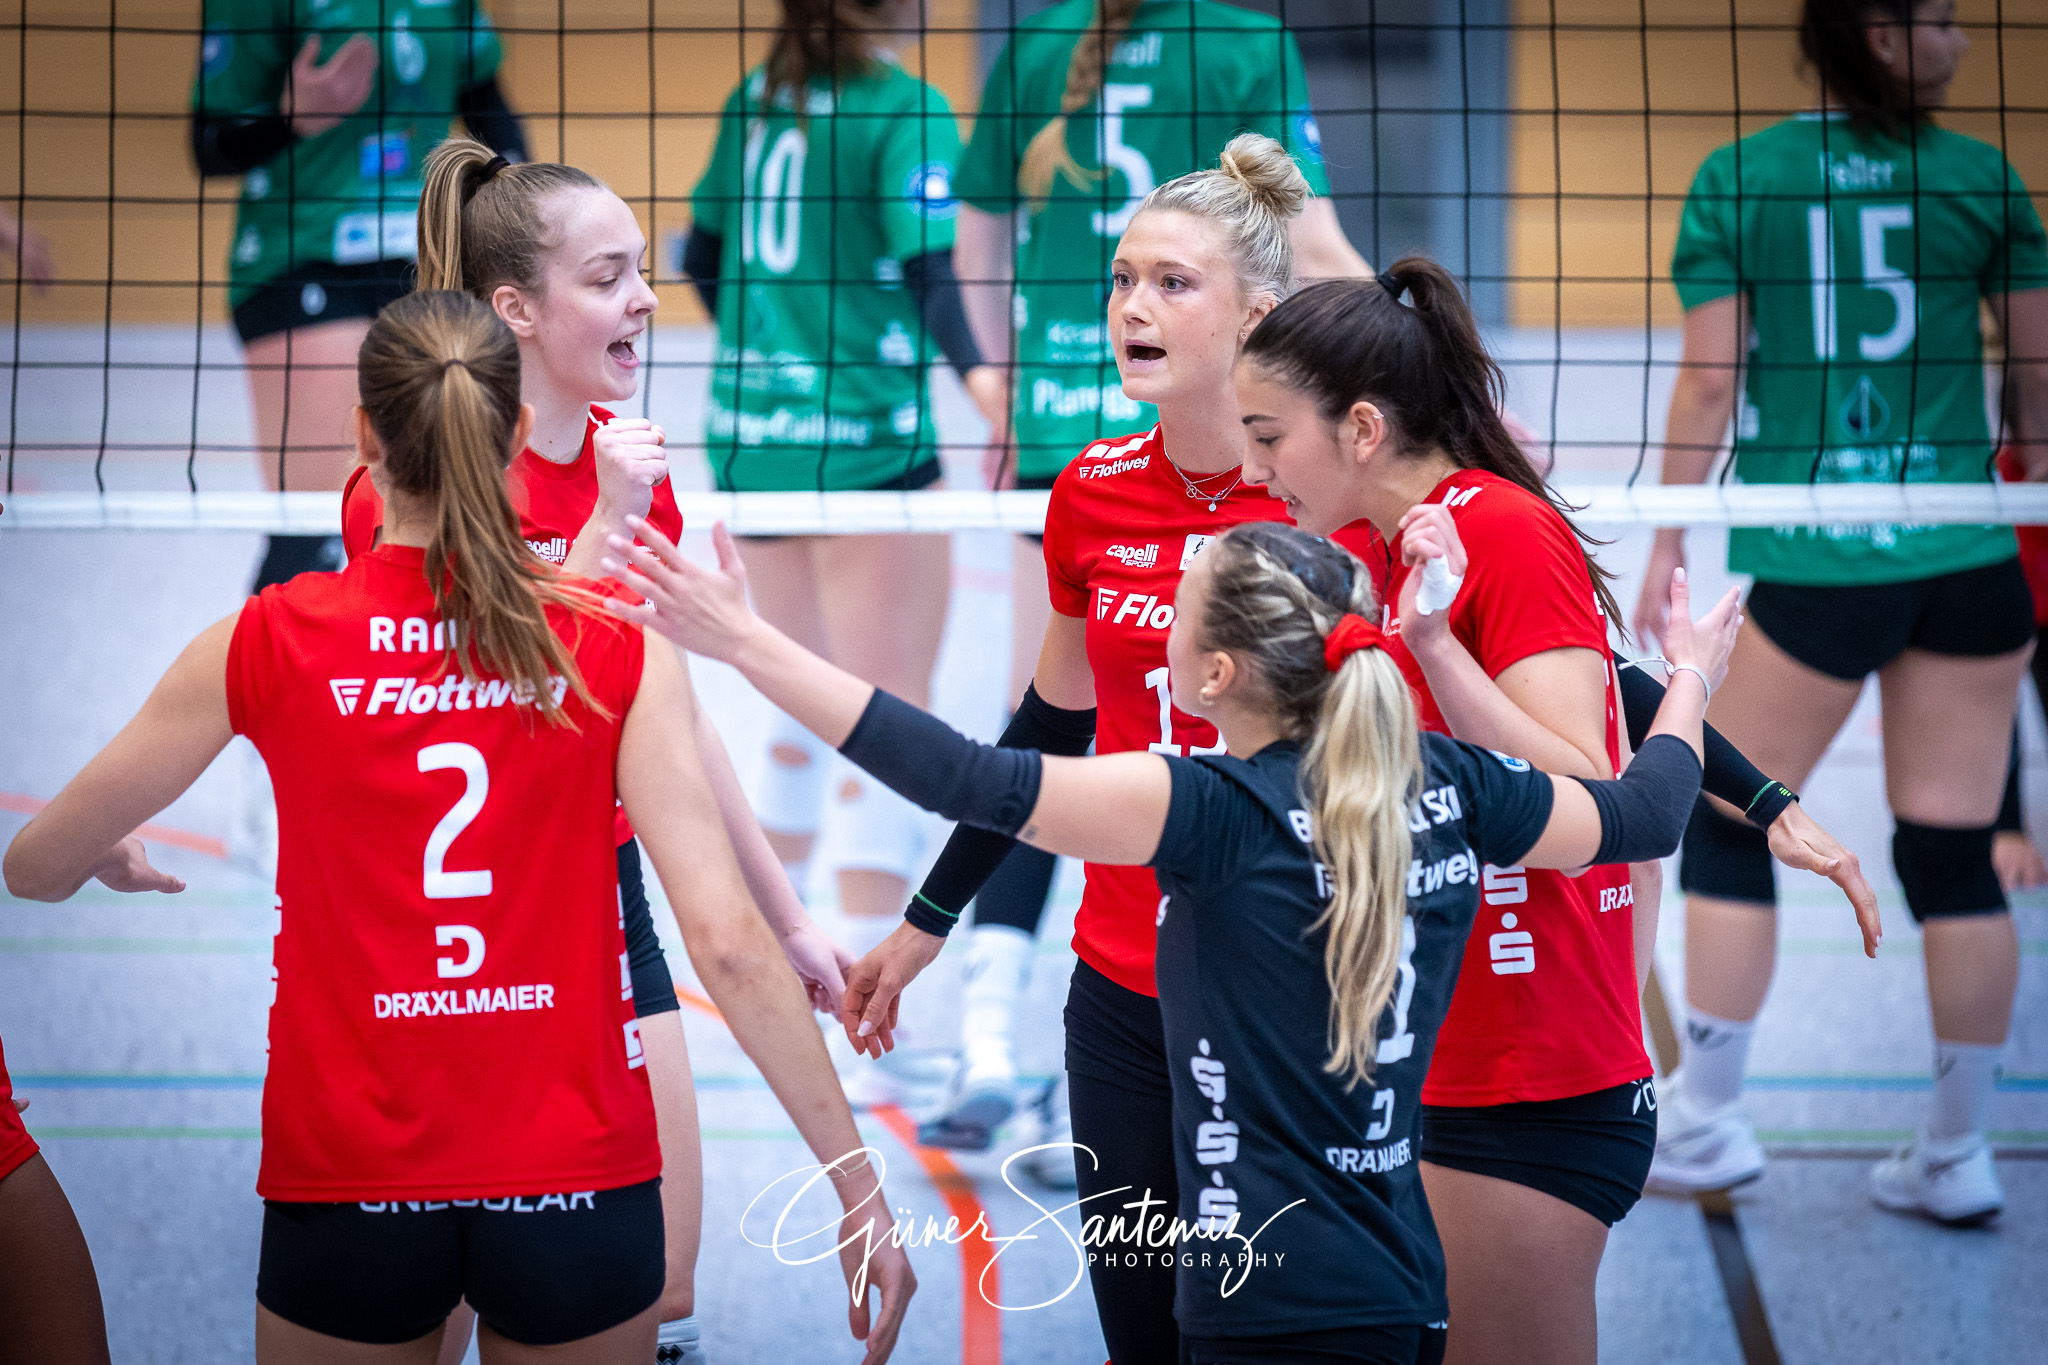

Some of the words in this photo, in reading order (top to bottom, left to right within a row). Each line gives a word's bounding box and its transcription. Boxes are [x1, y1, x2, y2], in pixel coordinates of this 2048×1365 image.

[742, 117, 808, 273] 10
[1092, 82, 1155, 238] 5
[1807, 204, 1922, 362] 15
[1089, 454, 1151, 480] Flottweg
[1105, 543, 1160, 563] capelli
[1124, 559, 1156, 569] SPORT
[417, 742, 493, 899] 2
[374, 984, 555, 1018] DRÄXLMAIER
